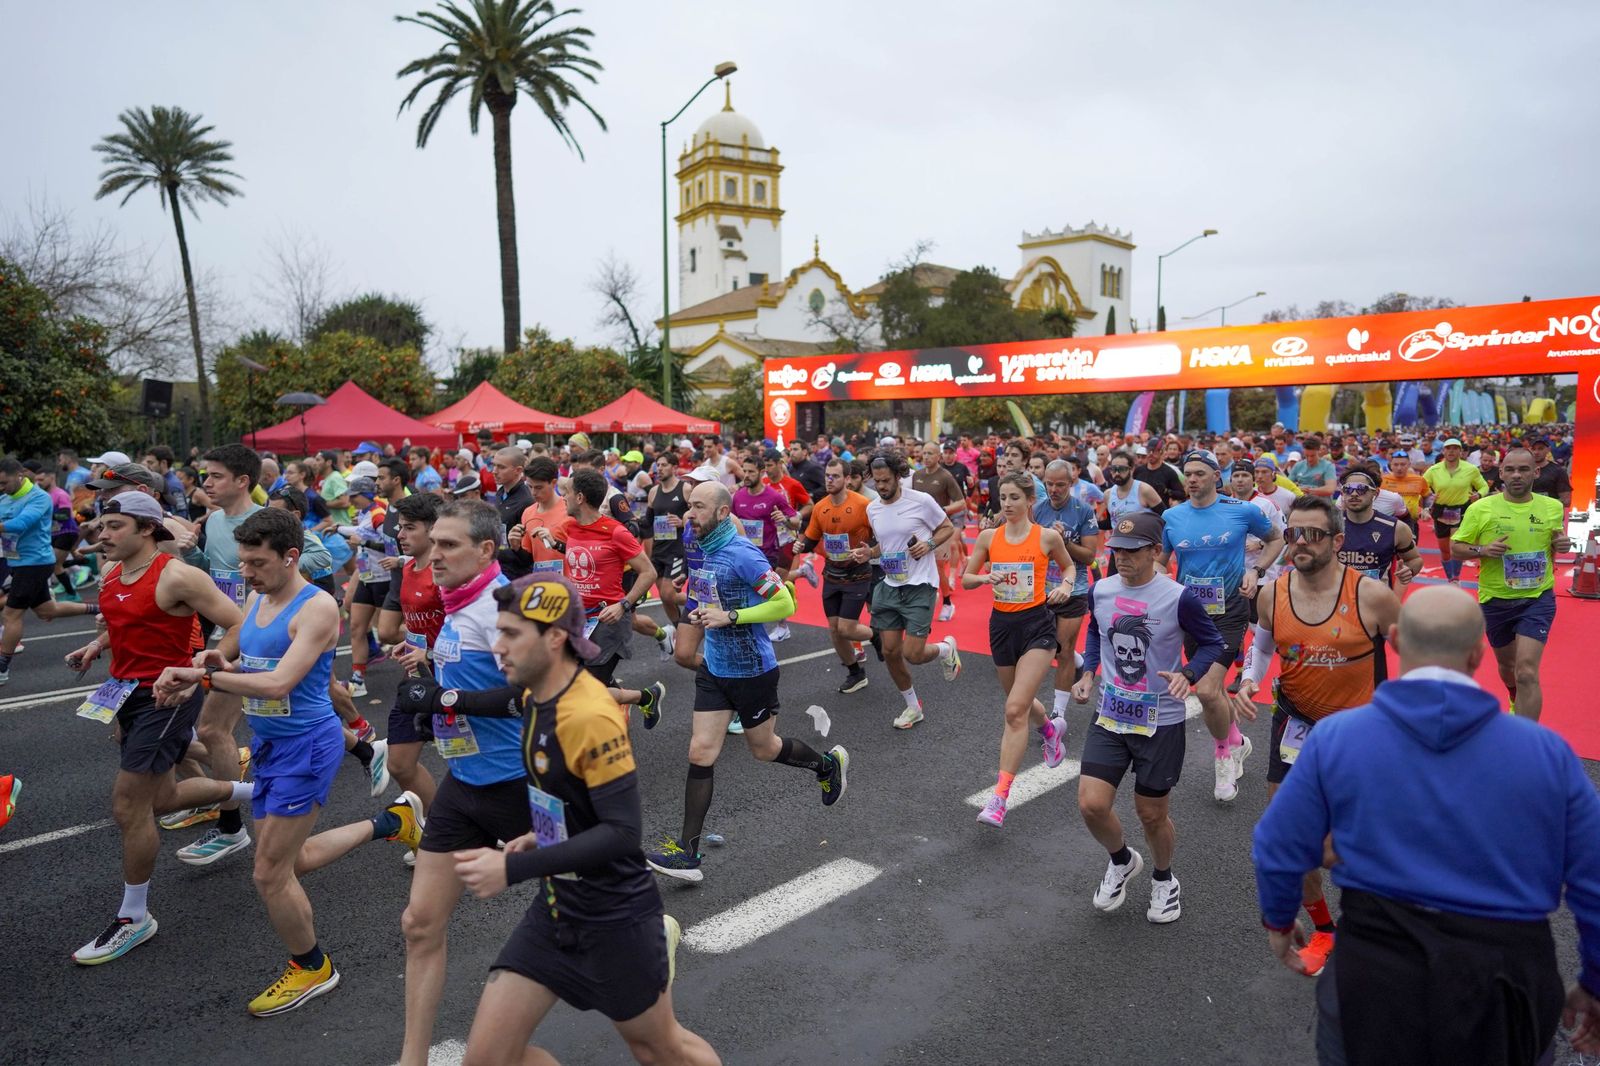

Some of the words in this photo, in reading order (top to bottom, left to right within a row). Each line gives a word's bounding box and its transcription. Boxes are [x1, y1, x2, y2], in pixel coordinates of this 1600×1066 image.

[1445, 329, 1549, 350] Sprinter
[1189, 344, 1253, 367] HOKA
[1511, 560, 1540, 573] 2509
[523, 586, 570, 617] Buff
[1110, 697, 1144, 718] 3846
